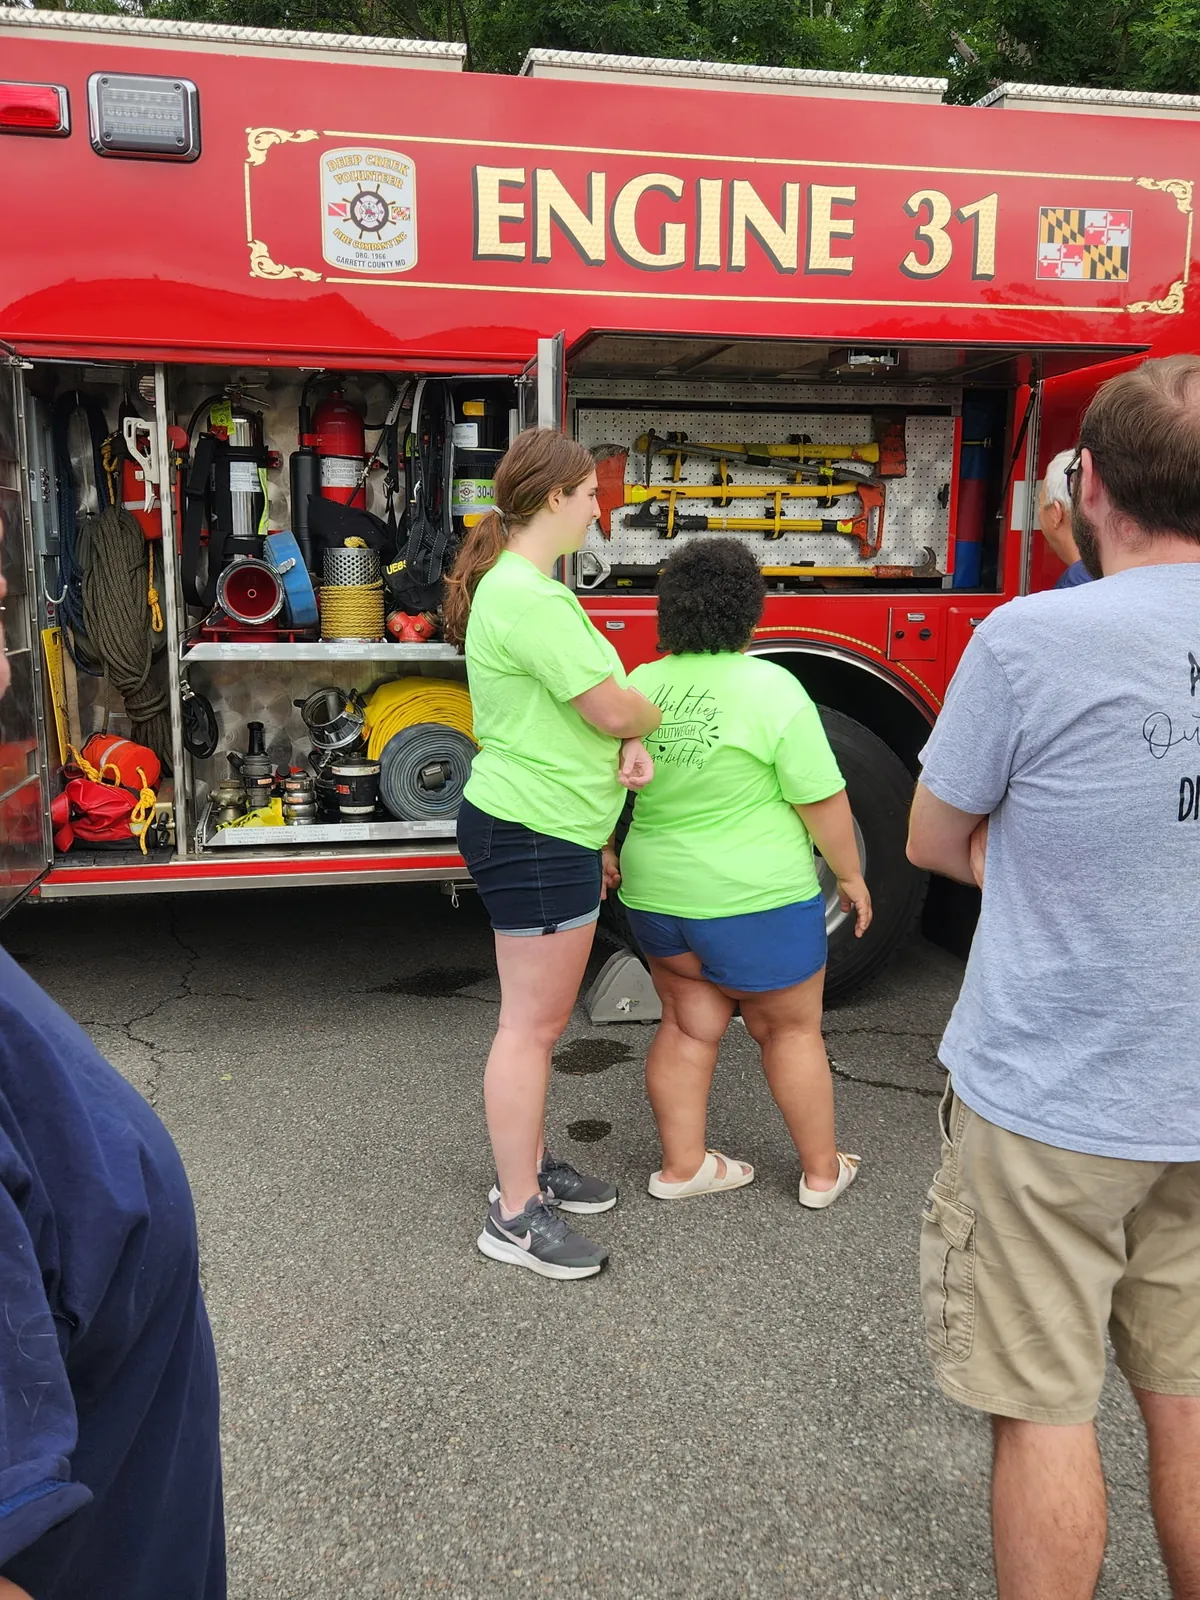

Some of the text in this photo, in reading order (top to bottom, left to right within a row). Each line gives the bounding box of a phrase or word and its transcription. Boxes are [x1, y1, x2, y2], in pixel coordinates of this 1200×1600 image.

[326, 154, 410, 177] DEEP CREEK
[333, 169, 404, 189] VOLUNTEER
[472, 164, 999, 283] ENGINE 31
[333, 227, 408, 251] FIRE COMPANY INC
[335, 255, 406, 269] GARRETT COUNTY MD
[371, 252, 386, 260] 1966
[657, 724, 697, 739] OUTWEIGH
